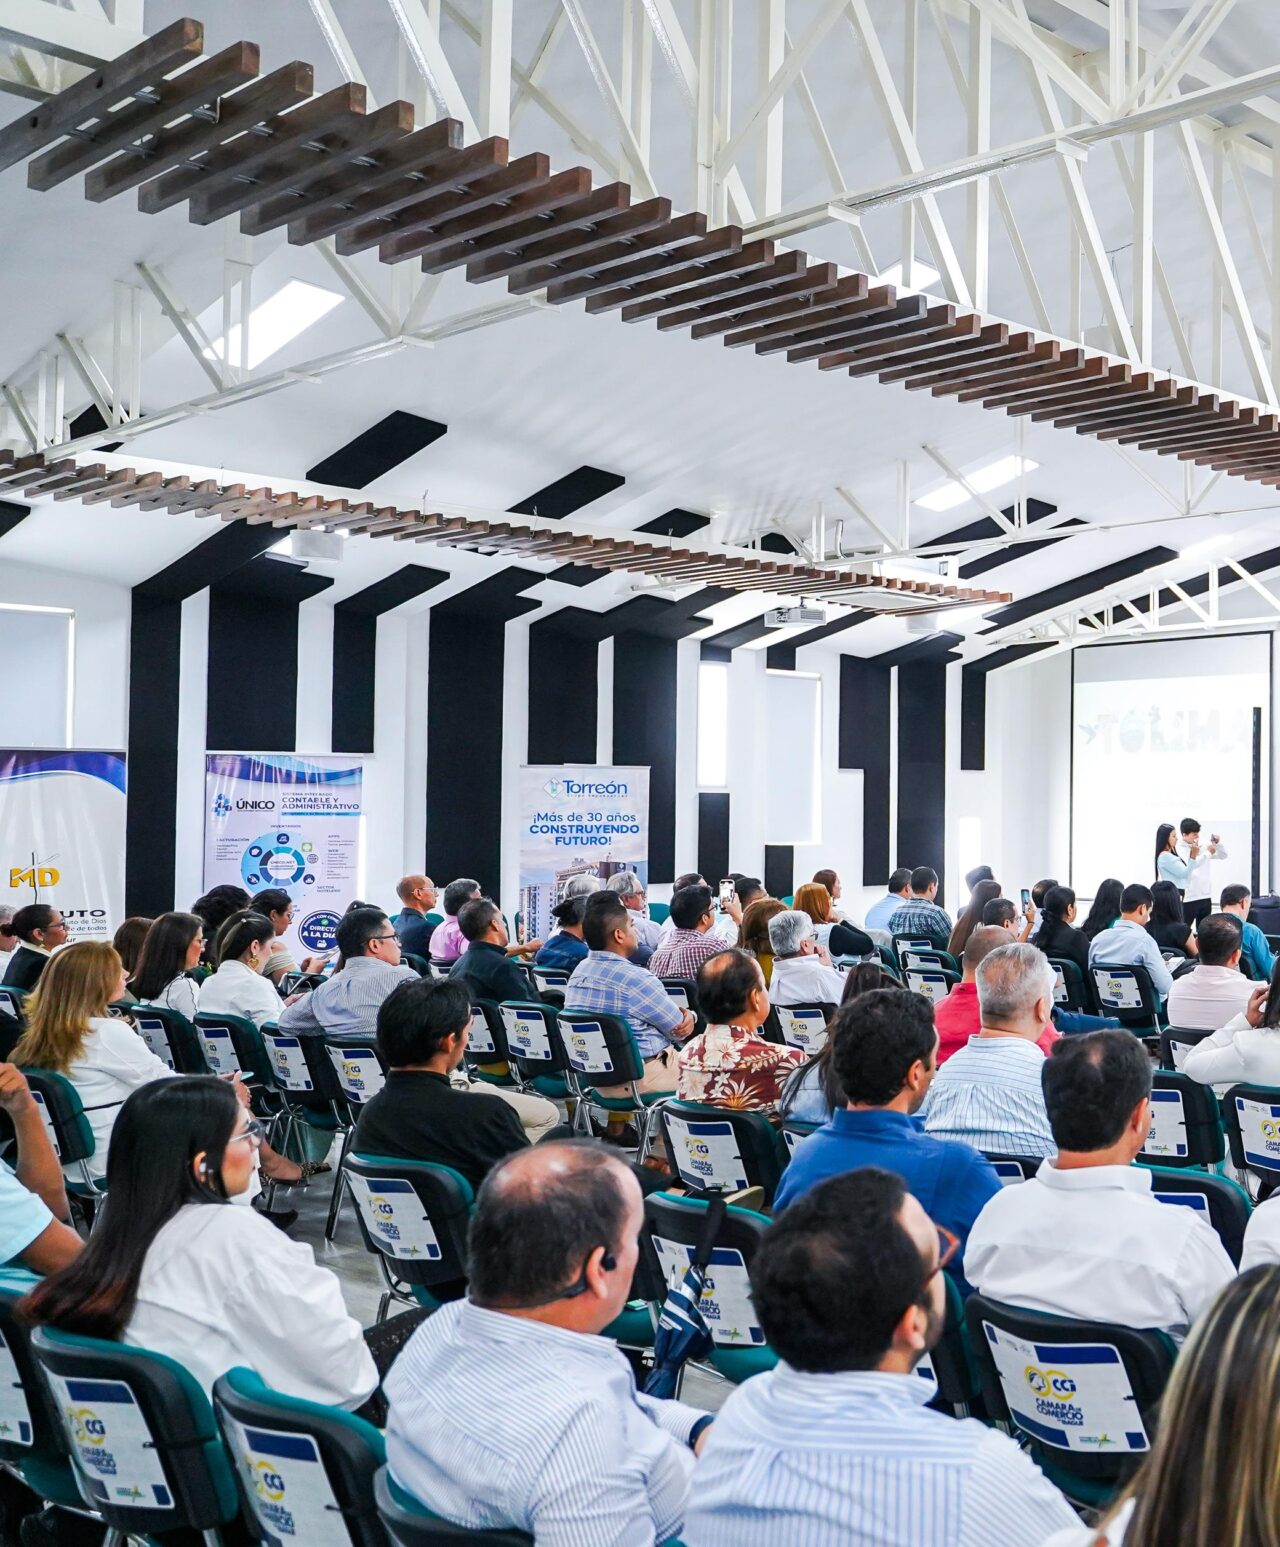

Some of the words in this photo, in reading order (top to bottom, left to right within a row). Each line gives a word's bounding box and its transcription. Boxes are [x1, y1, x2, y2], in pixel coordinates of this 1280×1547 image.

[563, 780, 628, 795] Torreón
[236, 798, 275, 810] ÚNICO
[533, 812, 563, 824] ¡Más
[567, 812, 583, 822] de
[587, 812, 603, 822] 30
[606, 813, 636, 822] años
[529, 825, 640, 834] CONSTRUYENDO
[555, 836, 612, 846] FUTURO!
[91, 917, 107, 925] Dios
[1036, 1398, 1075, 1412] CAMARA
[1036, 1405, 1084, 1420] COMERCIO
